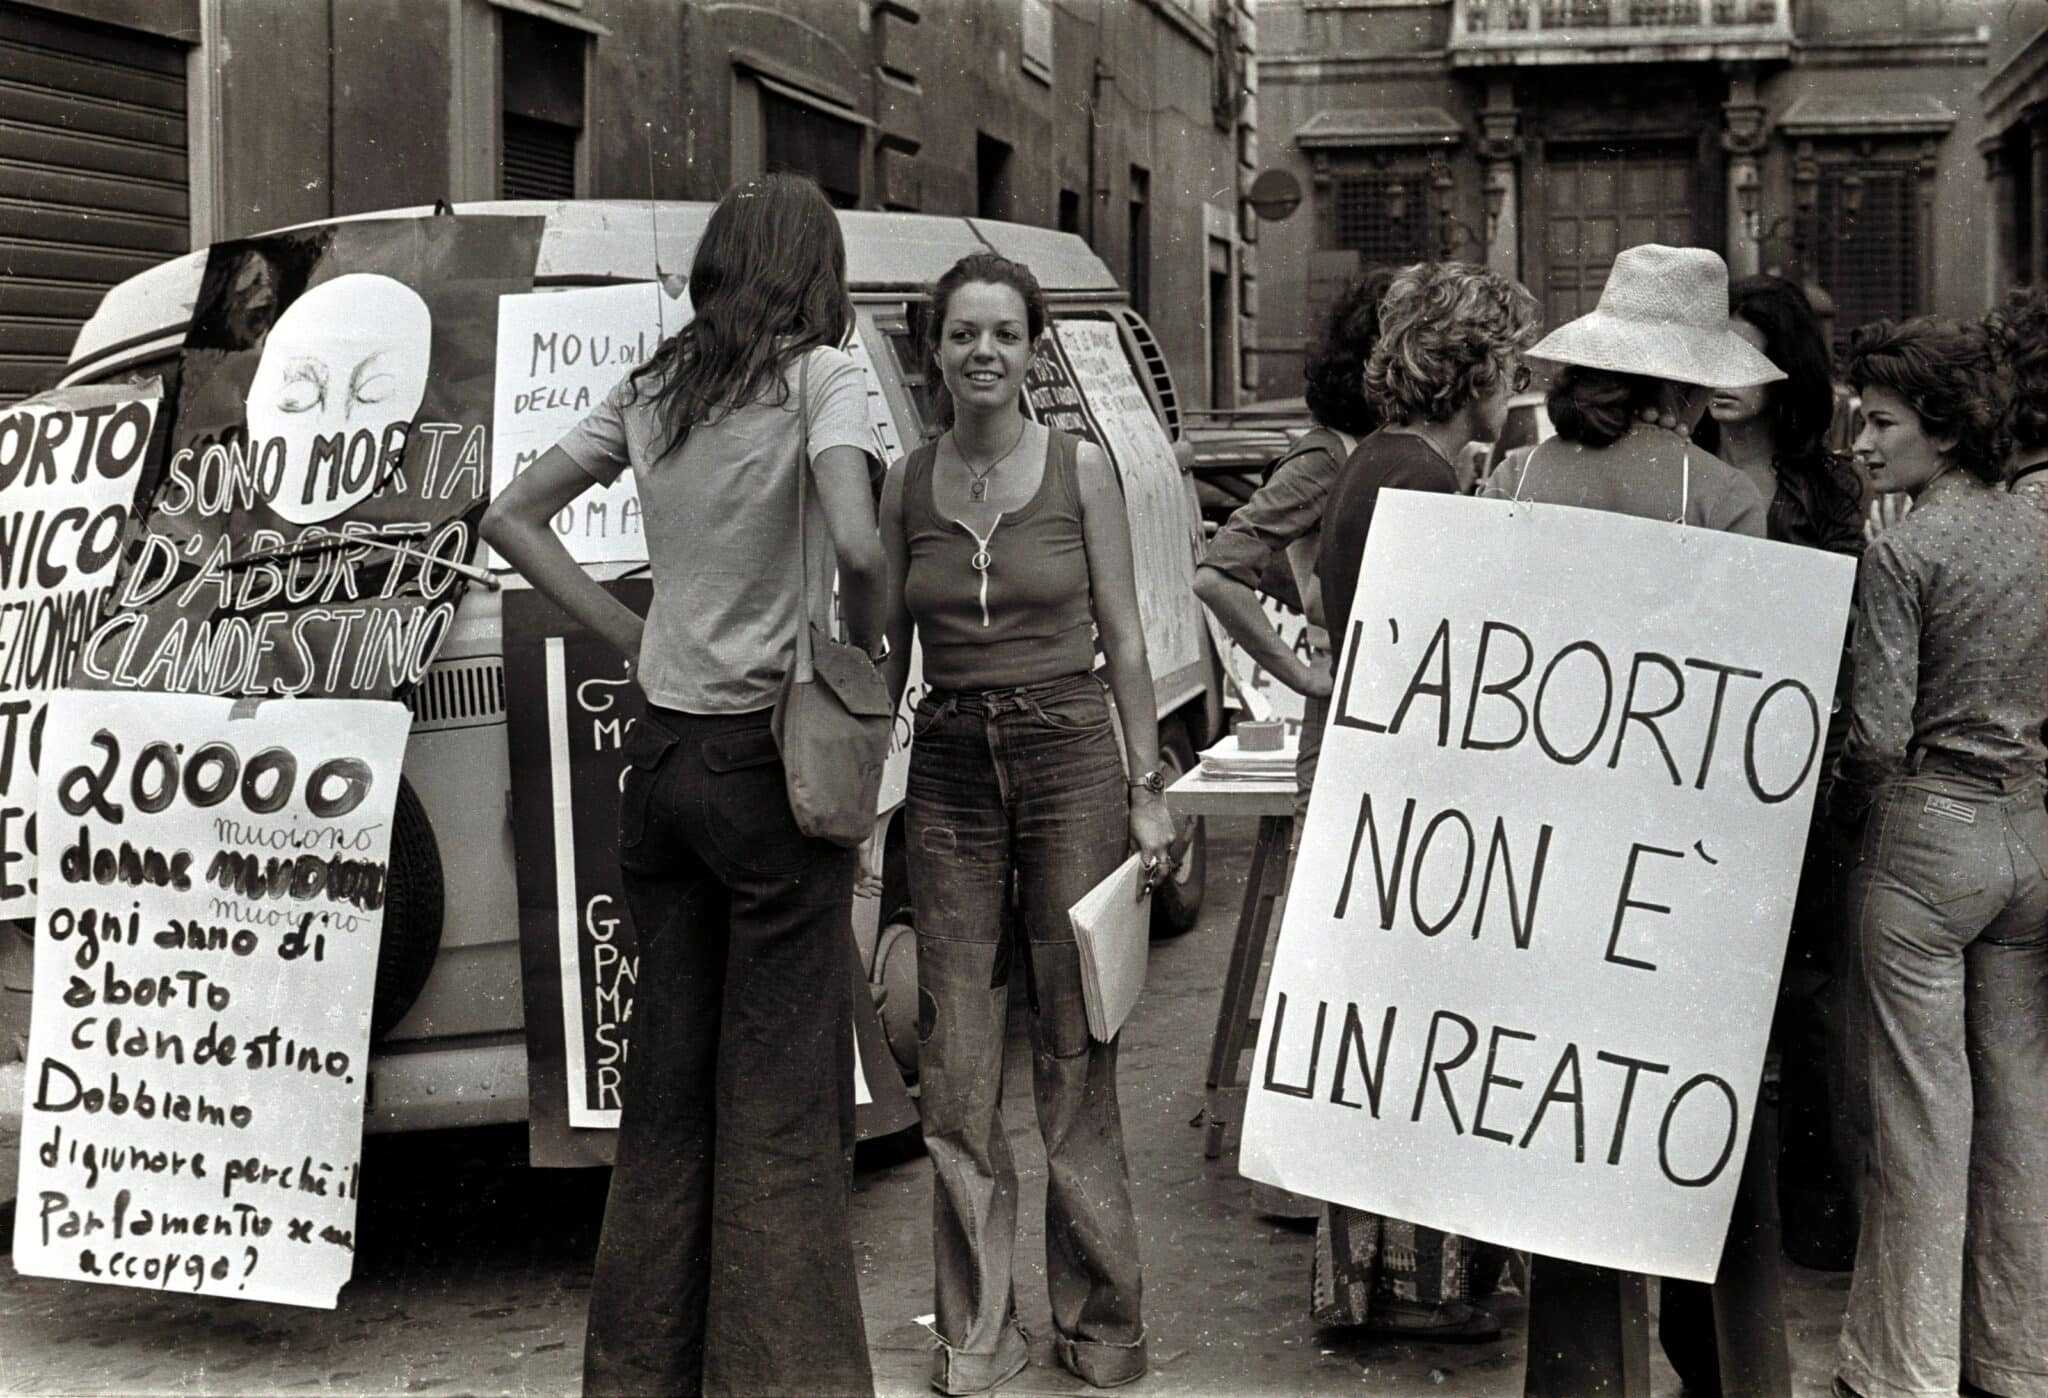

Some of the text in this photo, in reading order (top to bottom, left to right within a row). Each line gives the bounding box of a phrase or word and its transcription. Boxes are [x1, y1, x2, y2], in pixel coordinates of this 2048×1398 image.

[514, 386, 591, 415] DELLA
[158, 420, 486, 517] SONO MORTA
[82, 602, 455, 696] CLANDESTINO
[1333, 618, 1820, 804] L'ABORTO
[60, 824, 193, 892] donne
[1334, 793, 1553, 950] NON
[48, 901, 140, 970] ogni
[153, 919, 258, 957] anno
[33, 1057, 252, 1129] Dobbiamo
[1262, 991, 1739, 1187] UN REATO
